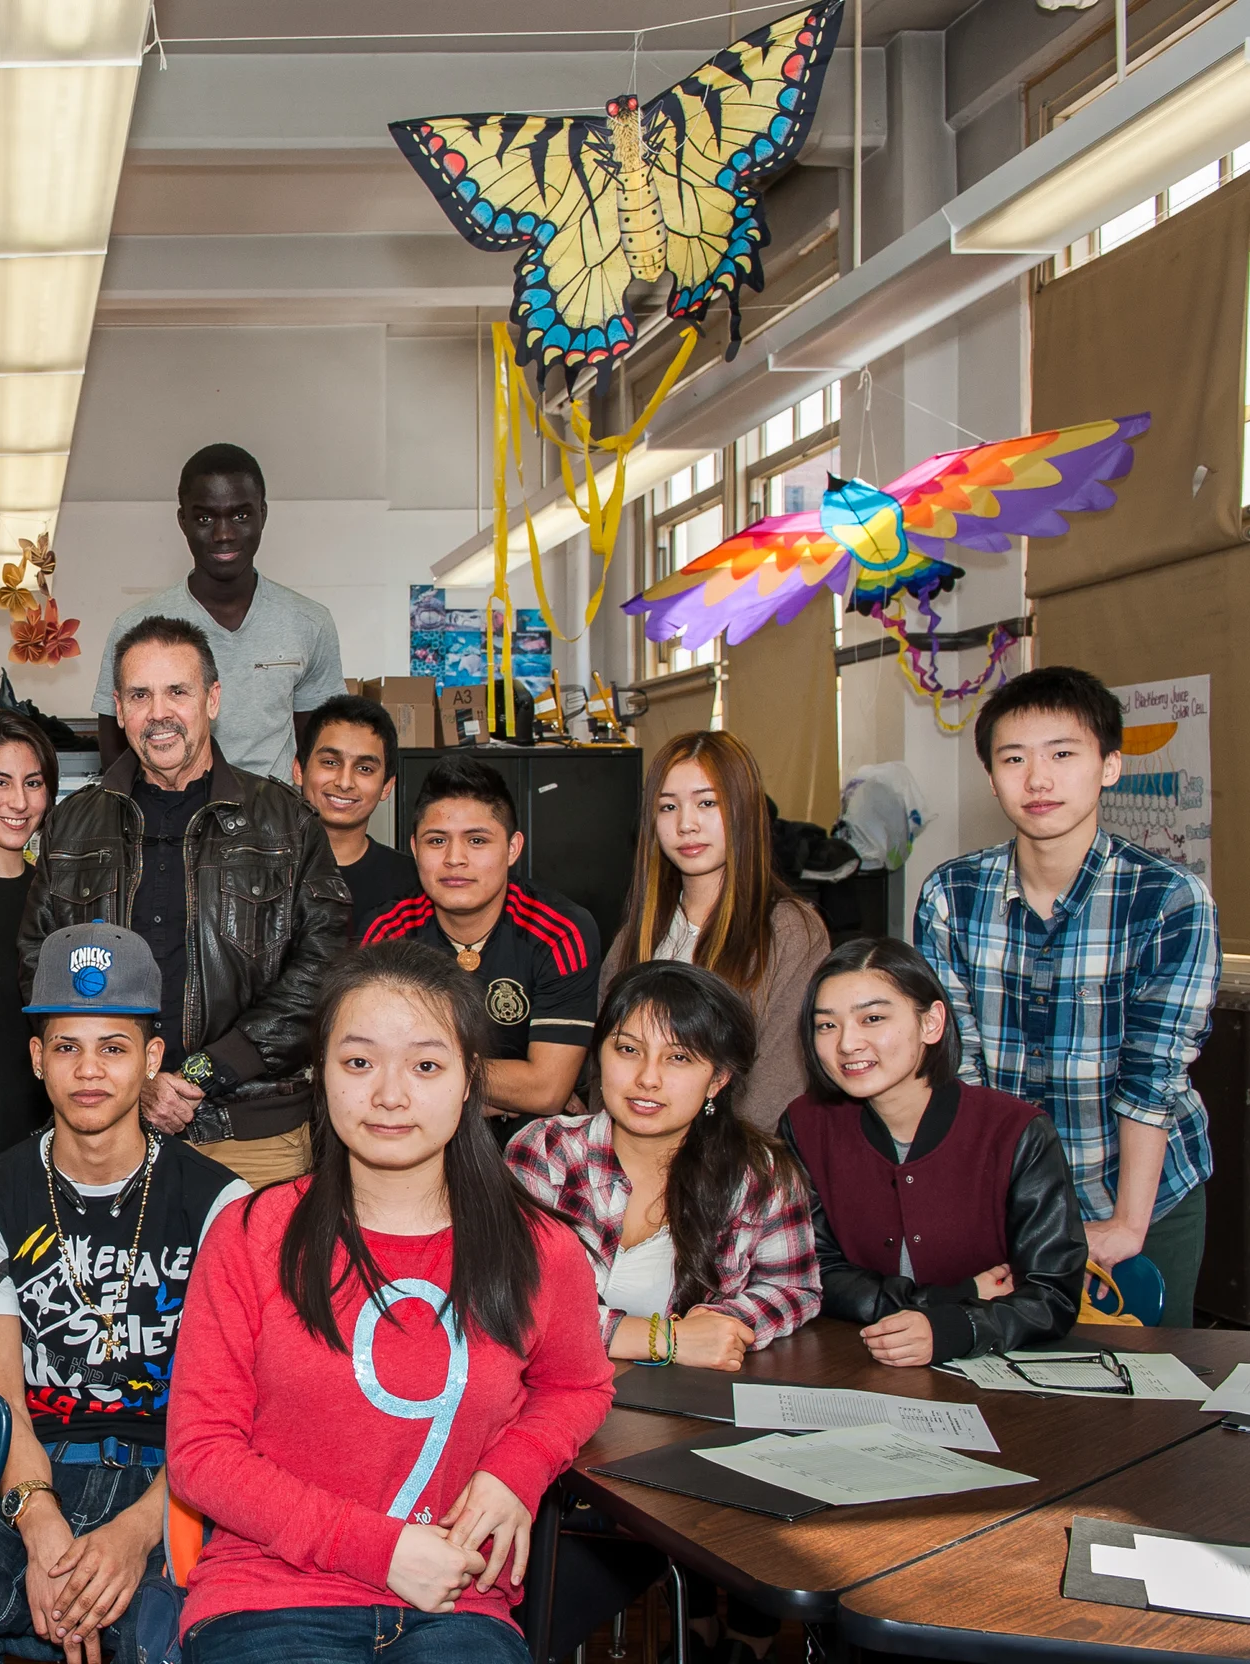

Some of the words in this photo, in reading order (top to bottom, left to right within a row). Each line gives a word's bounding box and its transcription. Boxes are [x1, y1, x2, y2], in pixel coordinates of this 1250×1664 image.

[453, 689, 473, 706] A3
[69, 946, 112, 973] KNICKS
[100, 1281, 130, 1314] 2
[353, 1278, 469, 1520] 9
